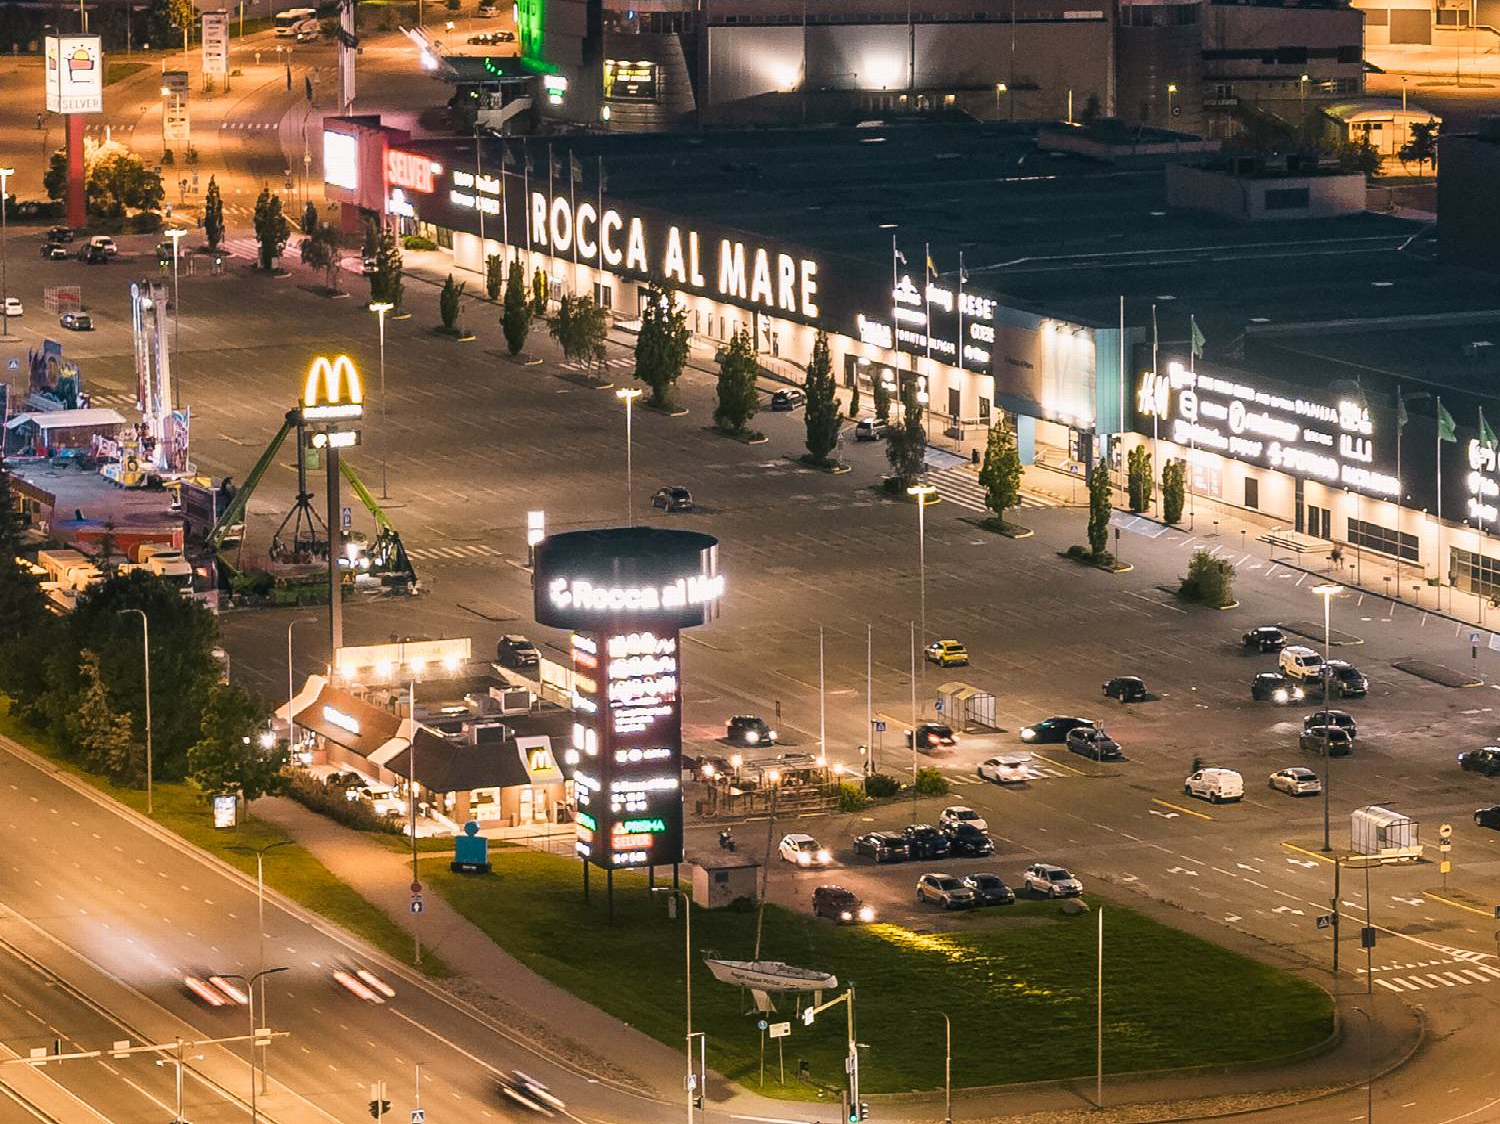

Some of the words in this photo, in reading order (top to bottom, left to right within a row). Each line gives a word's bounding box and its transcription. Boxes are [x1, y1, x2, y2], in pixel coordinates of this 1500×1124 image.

[62, 99, 100, 109] SELVER
[532, 192, 648, 273] ROCCA
[665, 226, 705, 287] AL
[719, 238, 819, 319] MARE
[572, 580, 660, 609] Rocca
[624, 818, 666, 833] PRISMA
